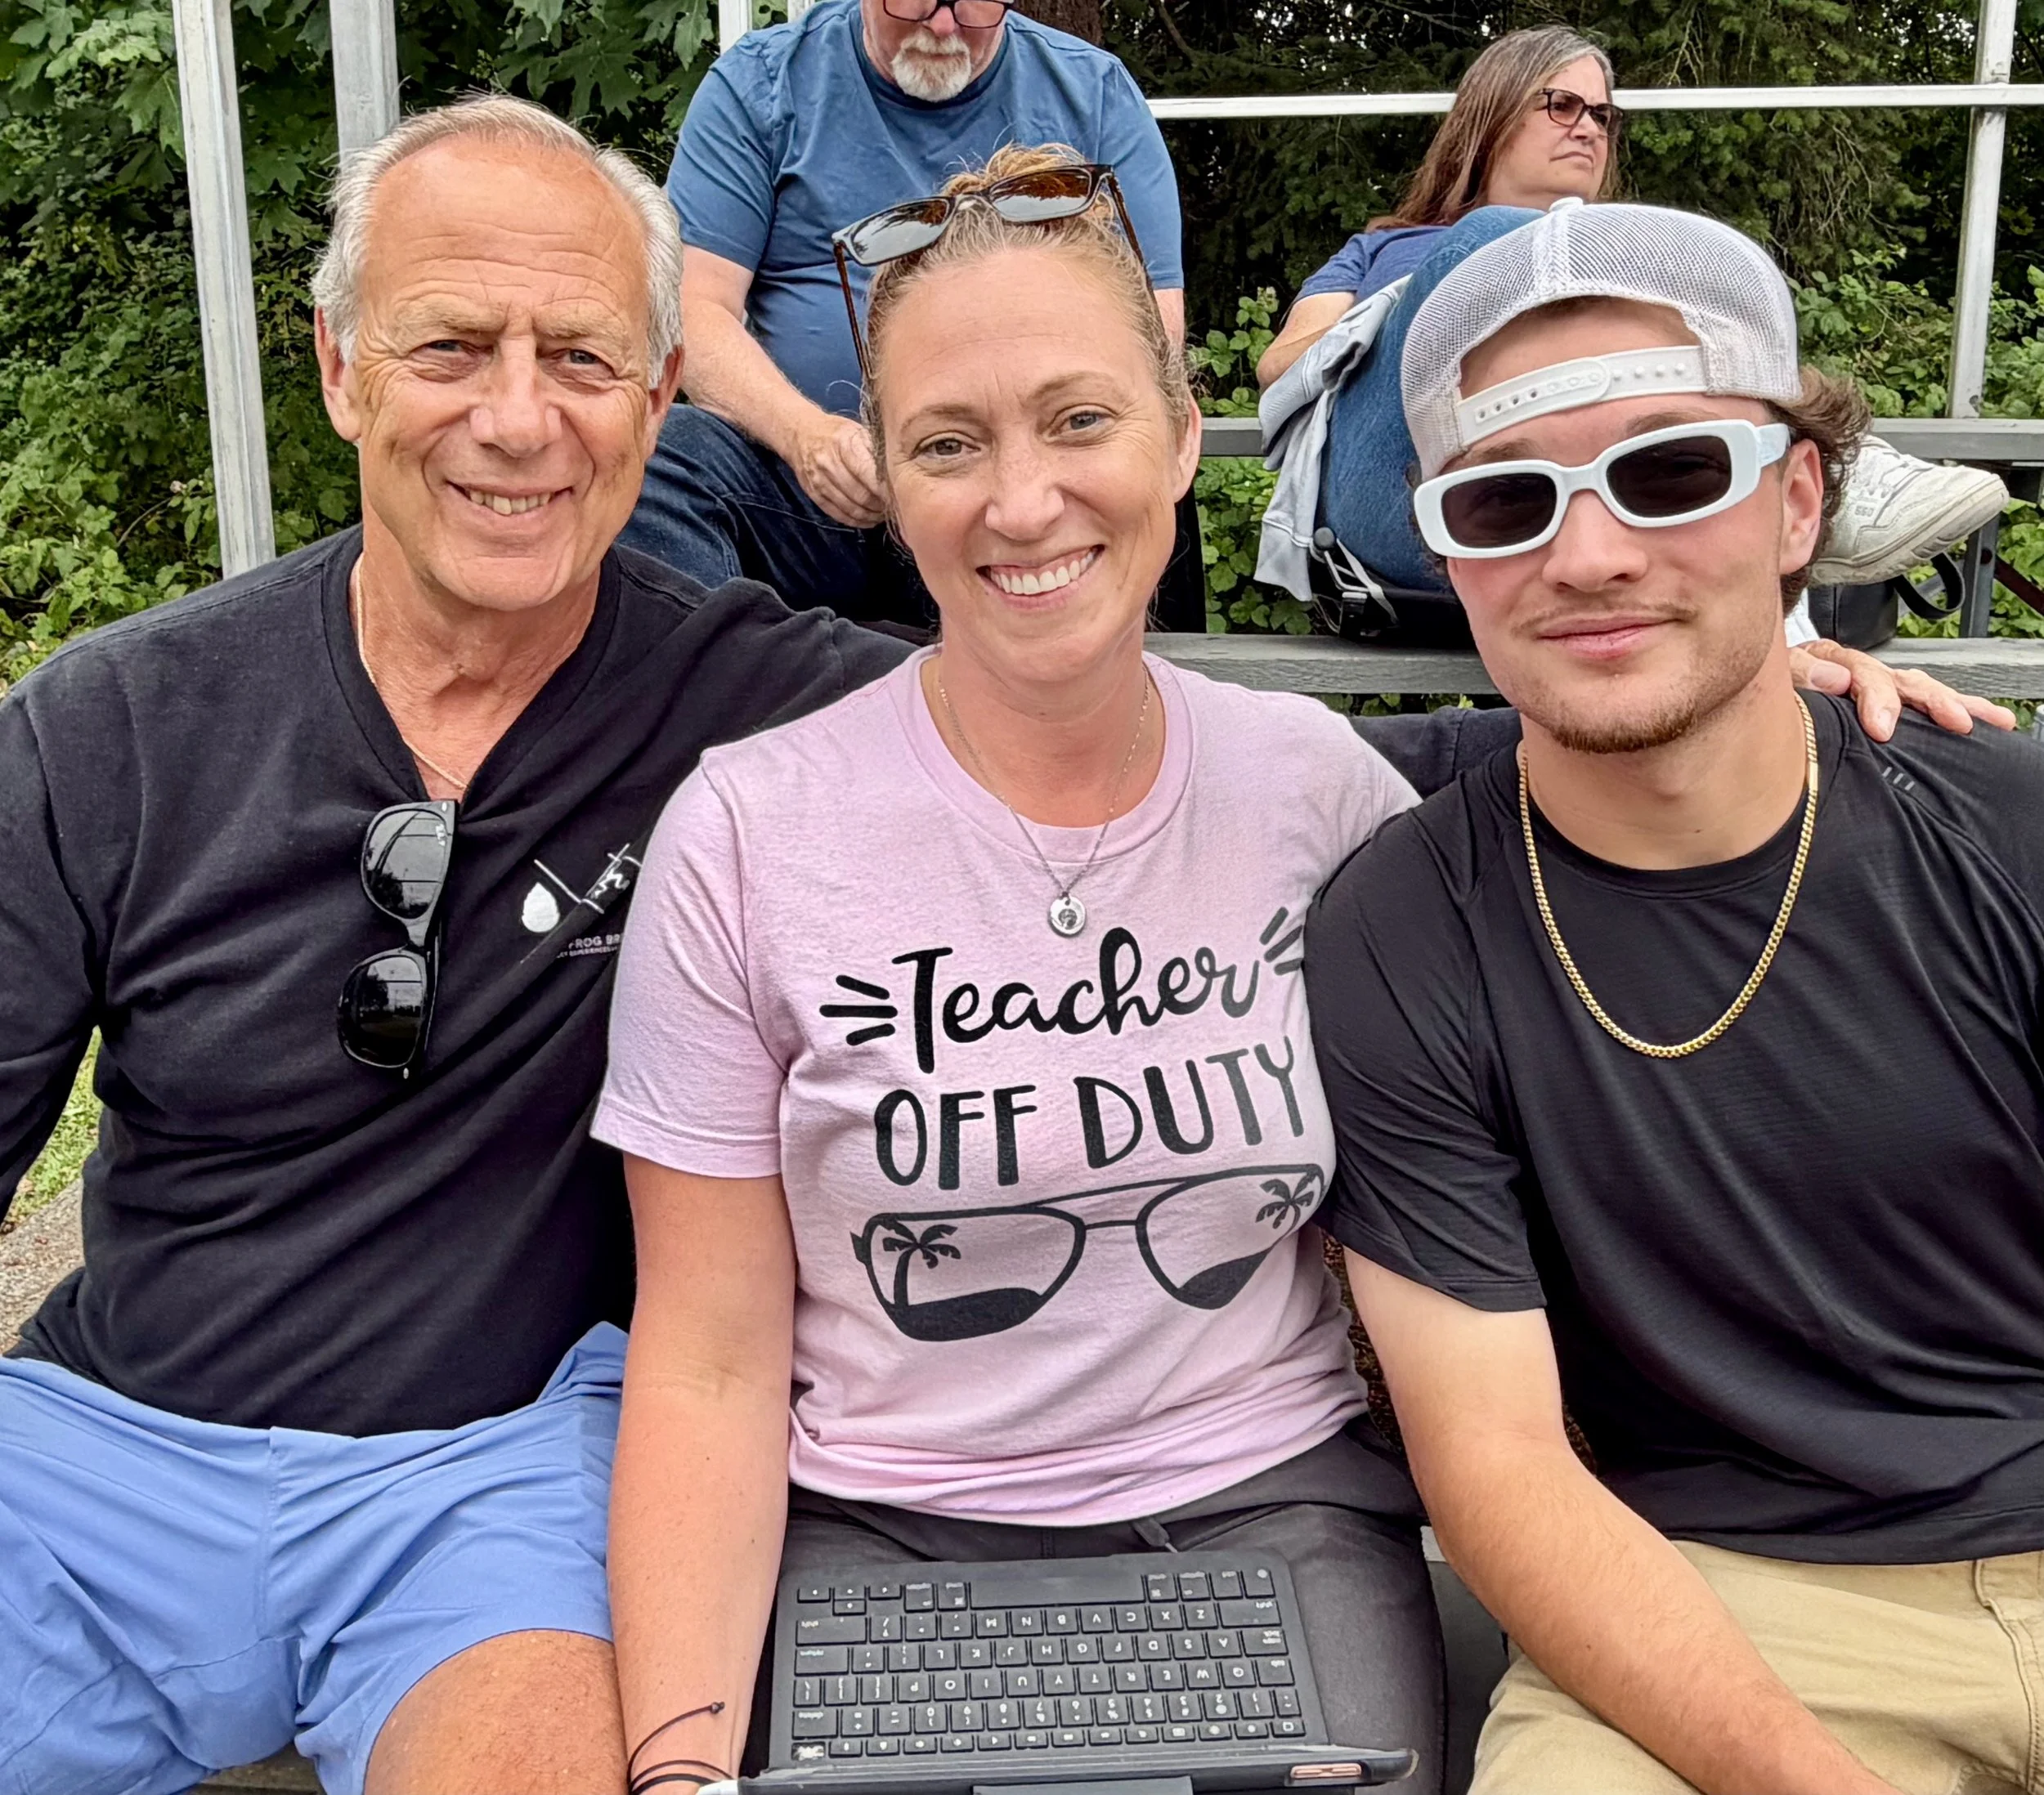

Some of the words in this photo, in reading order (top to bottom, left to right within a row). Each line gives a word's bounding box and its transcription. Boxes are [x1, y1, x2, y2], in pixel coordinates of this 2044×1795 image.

[892, 926, 1259, 1073] Teacher
[872, 1085, 1038, 1191] OFF
[1074, 1036, 1304, 1170] DUTY
[1092, 1614, 1101, 1623] V
[1126, 1612, 1136, 1622] C
[1161, 1611, 1170, 1620] X
[1196, 1609, 1204, 1619] Z
[986, 1618, 997, 1627] M
[1021, 1616, 1032, 1627] N
[1148, 1640, 1159, 1650] D
[1218, 1637, 1228, 1648] A
[937, 1649, 944, 1659] L
[1007, 1646, 1015, 1656] J
[1042, 1645, 1052, 1654] H
[1127, 1672, 1136, 1681] R
[1196, 1669, 1210, 1679] W
[1232, 1667, 1244, 1677] Q
[1017, 1676, 1028, 1686] U
[1055, 1675, 1063, 1685] Y
[1091, 1673, 1099, 1684] T
[910, 1681, 919, 1692] P
[944, 1680, 957, 1690] O
[1216, 1693, 1222, 1703] 2
